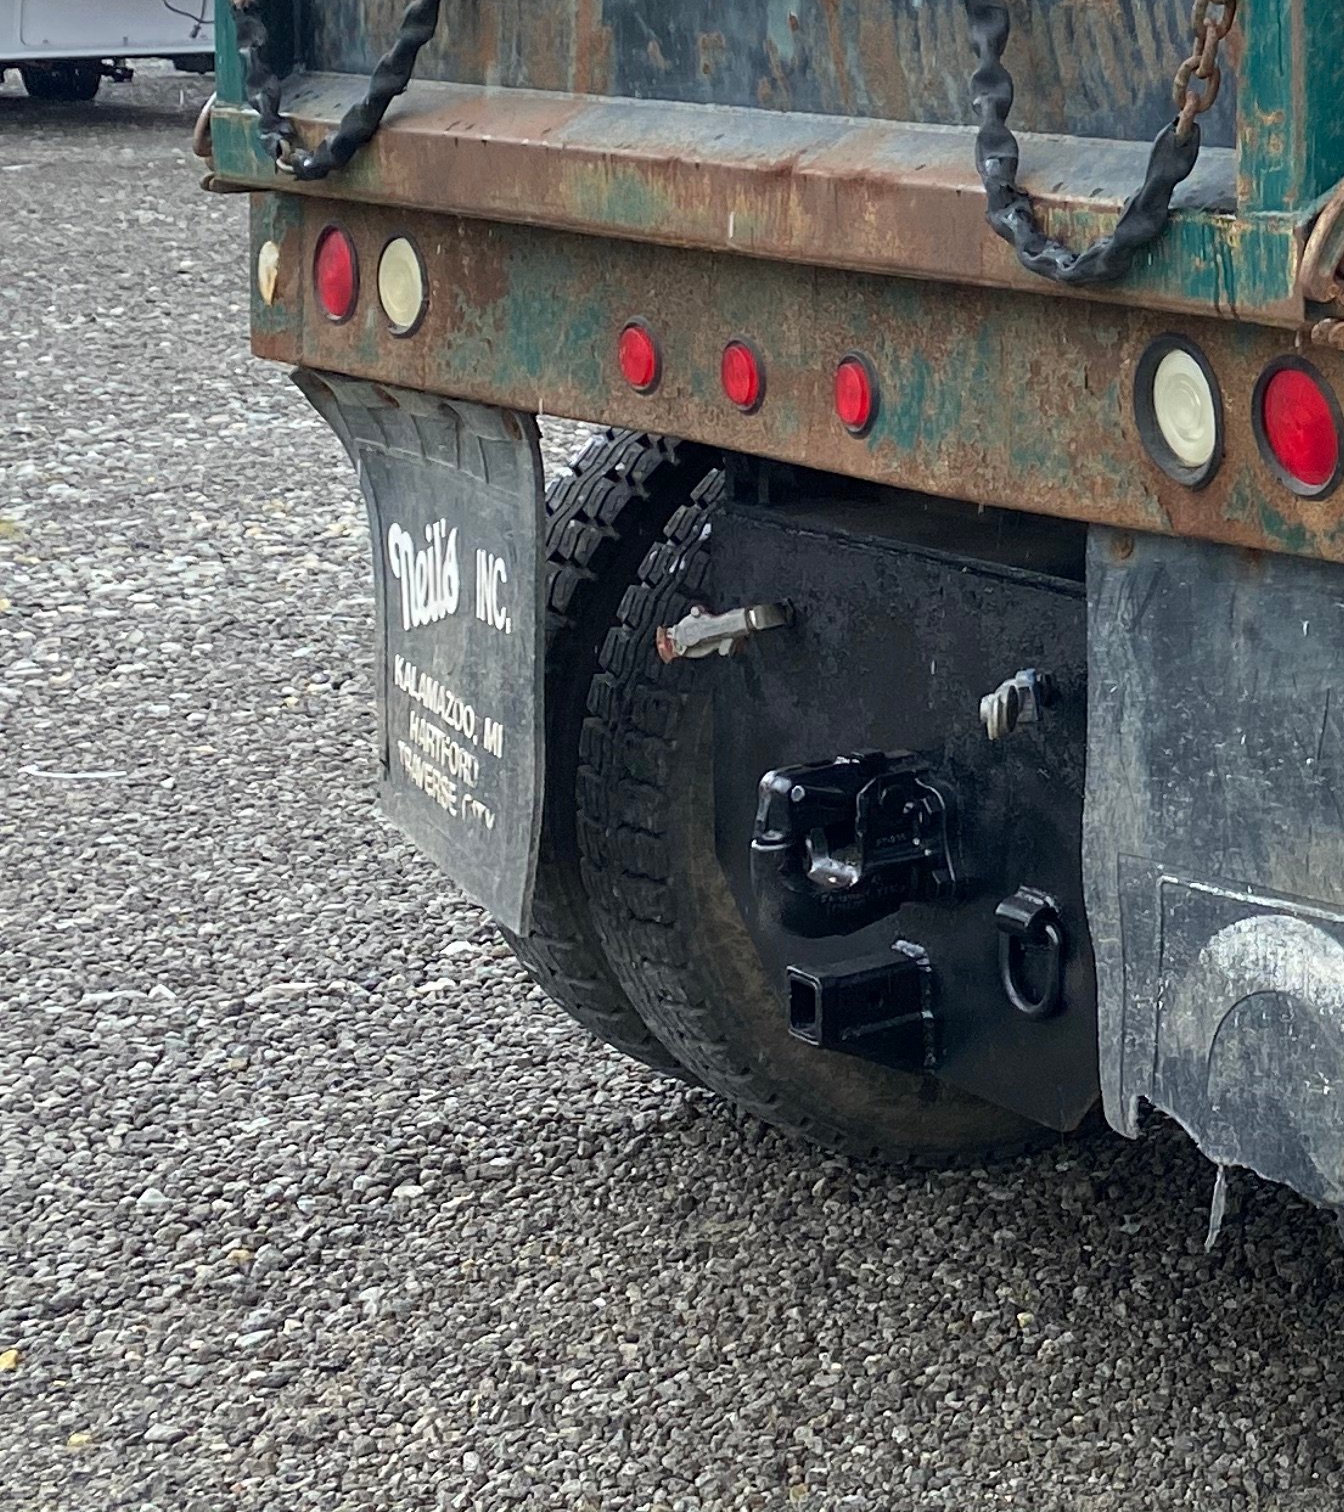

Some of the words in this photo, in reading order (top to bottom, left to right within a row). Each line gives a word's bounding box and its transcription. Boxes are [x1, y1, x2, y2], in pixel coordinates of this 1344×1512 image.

[475, 548, 512, 635] INC.
[410, 710, 479, 788] HARTFORD
[483, 717, 504, 759] MI
[397, 739, 457, 817] TRAVERSE
